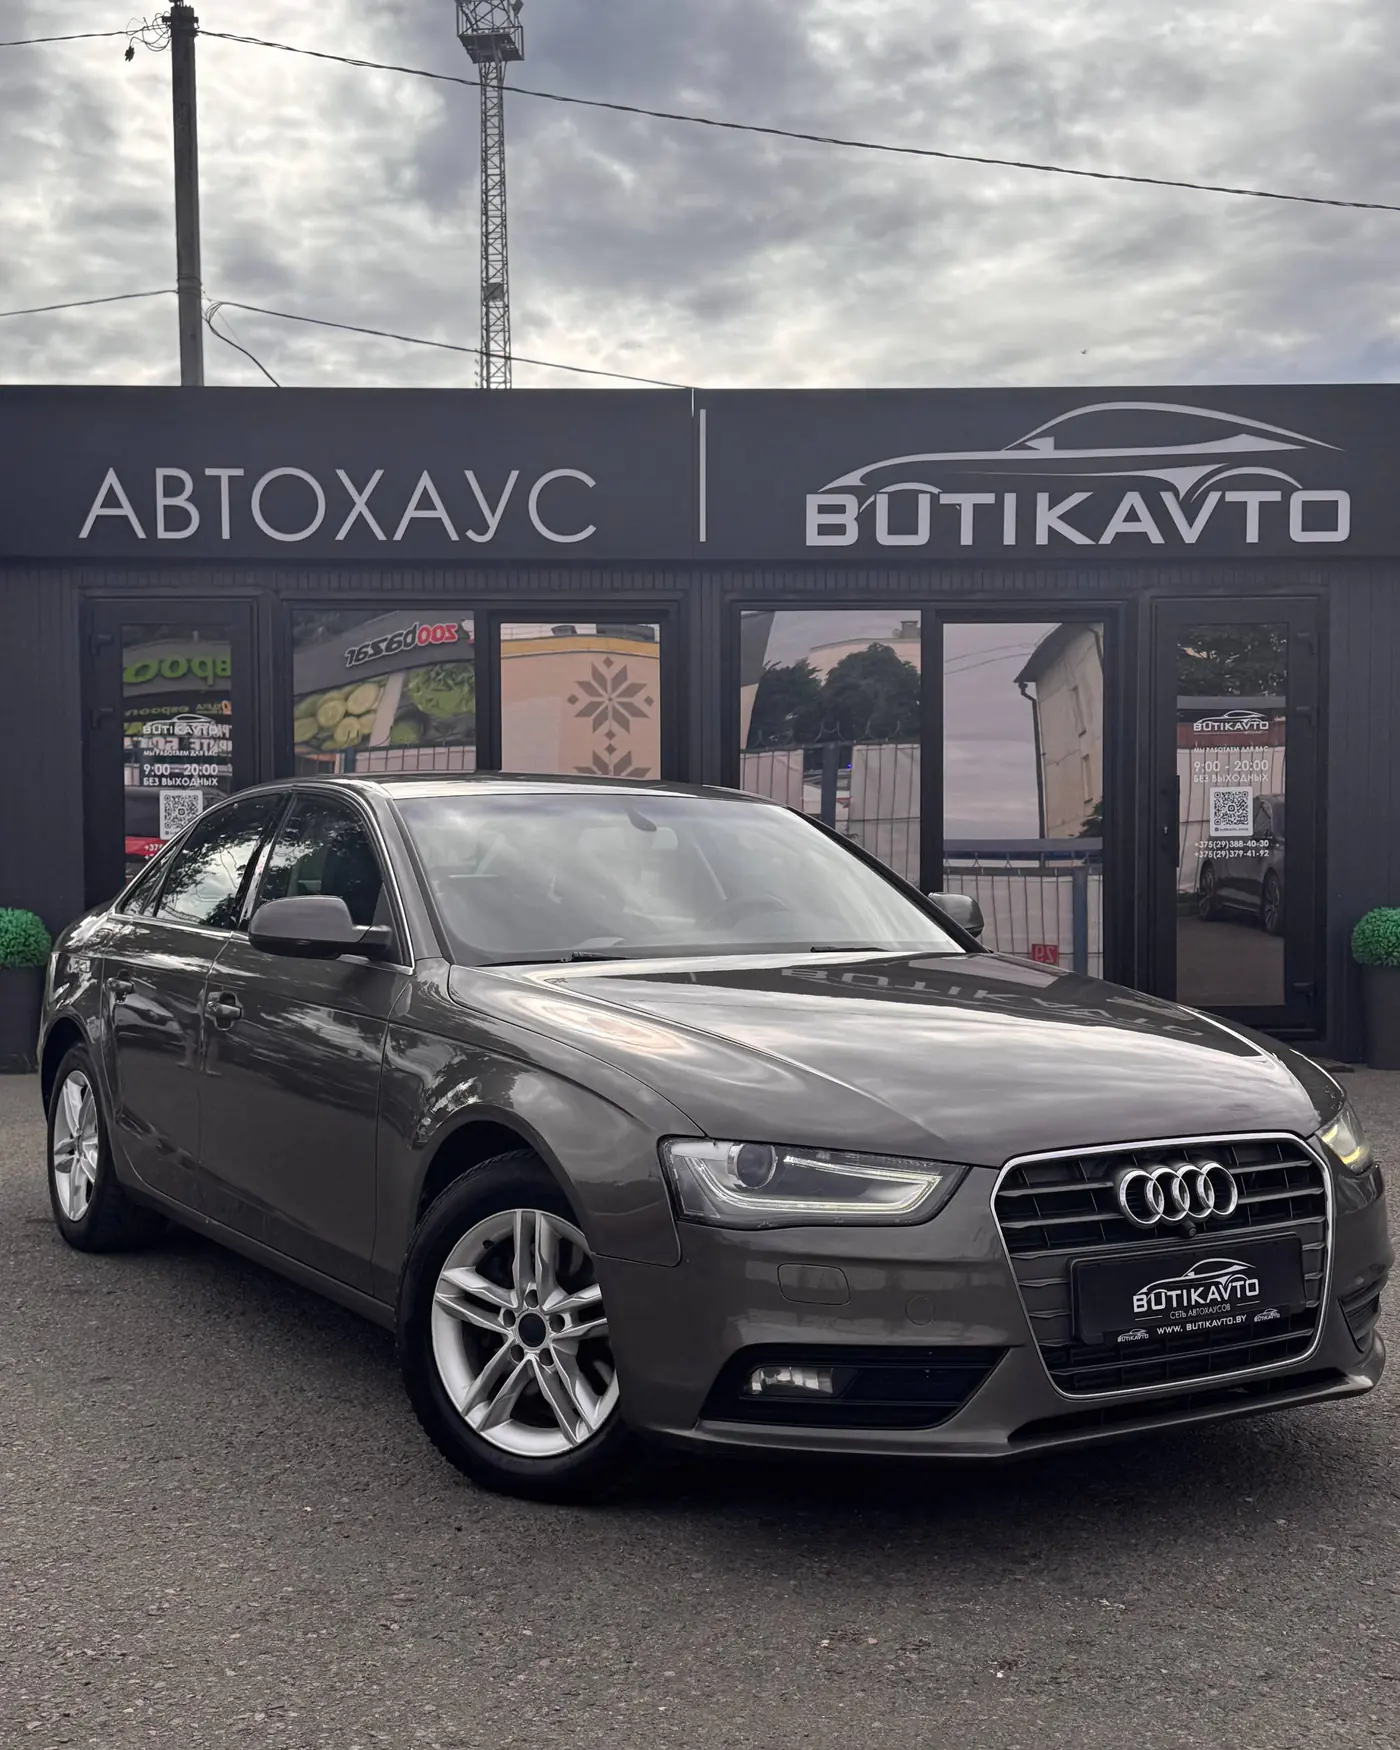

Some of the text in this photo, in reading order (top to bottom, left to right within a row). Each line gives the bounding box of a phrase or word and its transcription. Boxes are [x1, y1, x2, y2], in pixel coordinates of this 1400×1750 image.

[79, 467, 597, 543] АВТОХАУС
[806, 489, 1351, 546] BUTIKAVTO
[143, 725, 218, 735] BUTIKAVTO
[1193, 721, 1269, 731] BUTIKAVTO
[143, 764, 170, 775] 9:00
[183, 764, 218, 775] 20:00
[1194, 761, 1220, 772] 9:00
[1234, 760, 1269, 771] 20:00
[143, 777, 218, 786] БЕЗ ВЫХОДНЫХ
[1194, 774, 1269, 783] БЕЗ ВЫХОДНЫХ
[1194, 840, 1269, 849] +375(29)388-40-30
[1194, 850, 1269, 859] +375(29)379-41-92
[1133, 1279, 1259, 1312] BUTIKAVTO
[1170, 1303, 1231, 1319] СЕТЬ АВТОХАУСОВ
[1157, 1315, 1247, 1335] WWW. BUTIKAVTO.BY
